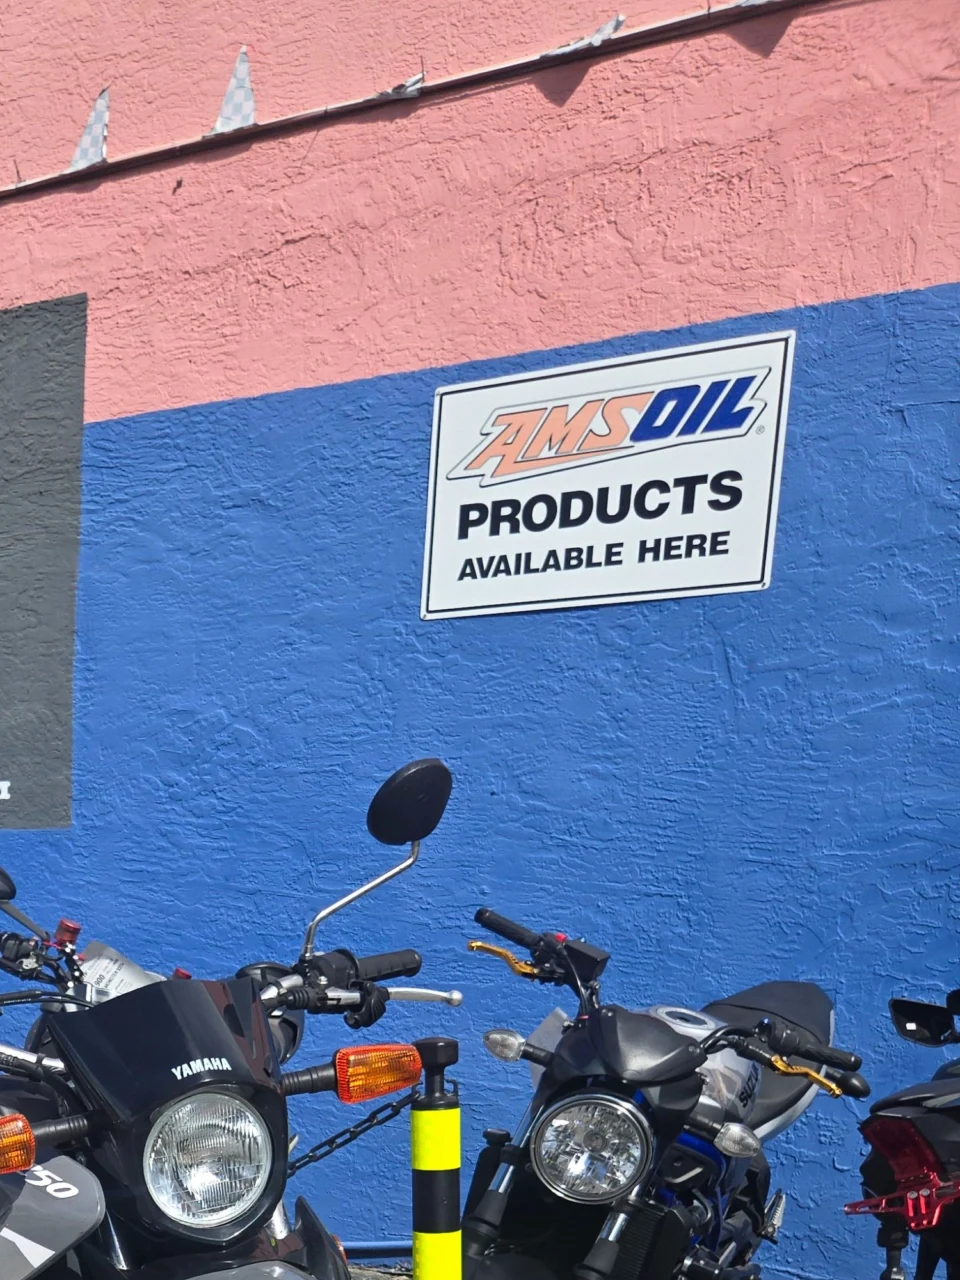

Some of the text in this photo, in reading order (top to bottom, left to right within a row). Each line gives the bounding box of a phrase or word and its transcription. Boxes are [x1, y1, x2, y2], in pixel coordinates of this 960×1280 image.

[464, 375, 758, 479] AMSOIL
[457, 469, 743, 540] PRODUCTS
[457, 531, 731, 582] AVAILABLE HERE
[171, 1057, 232, 1080] YAMAHA
